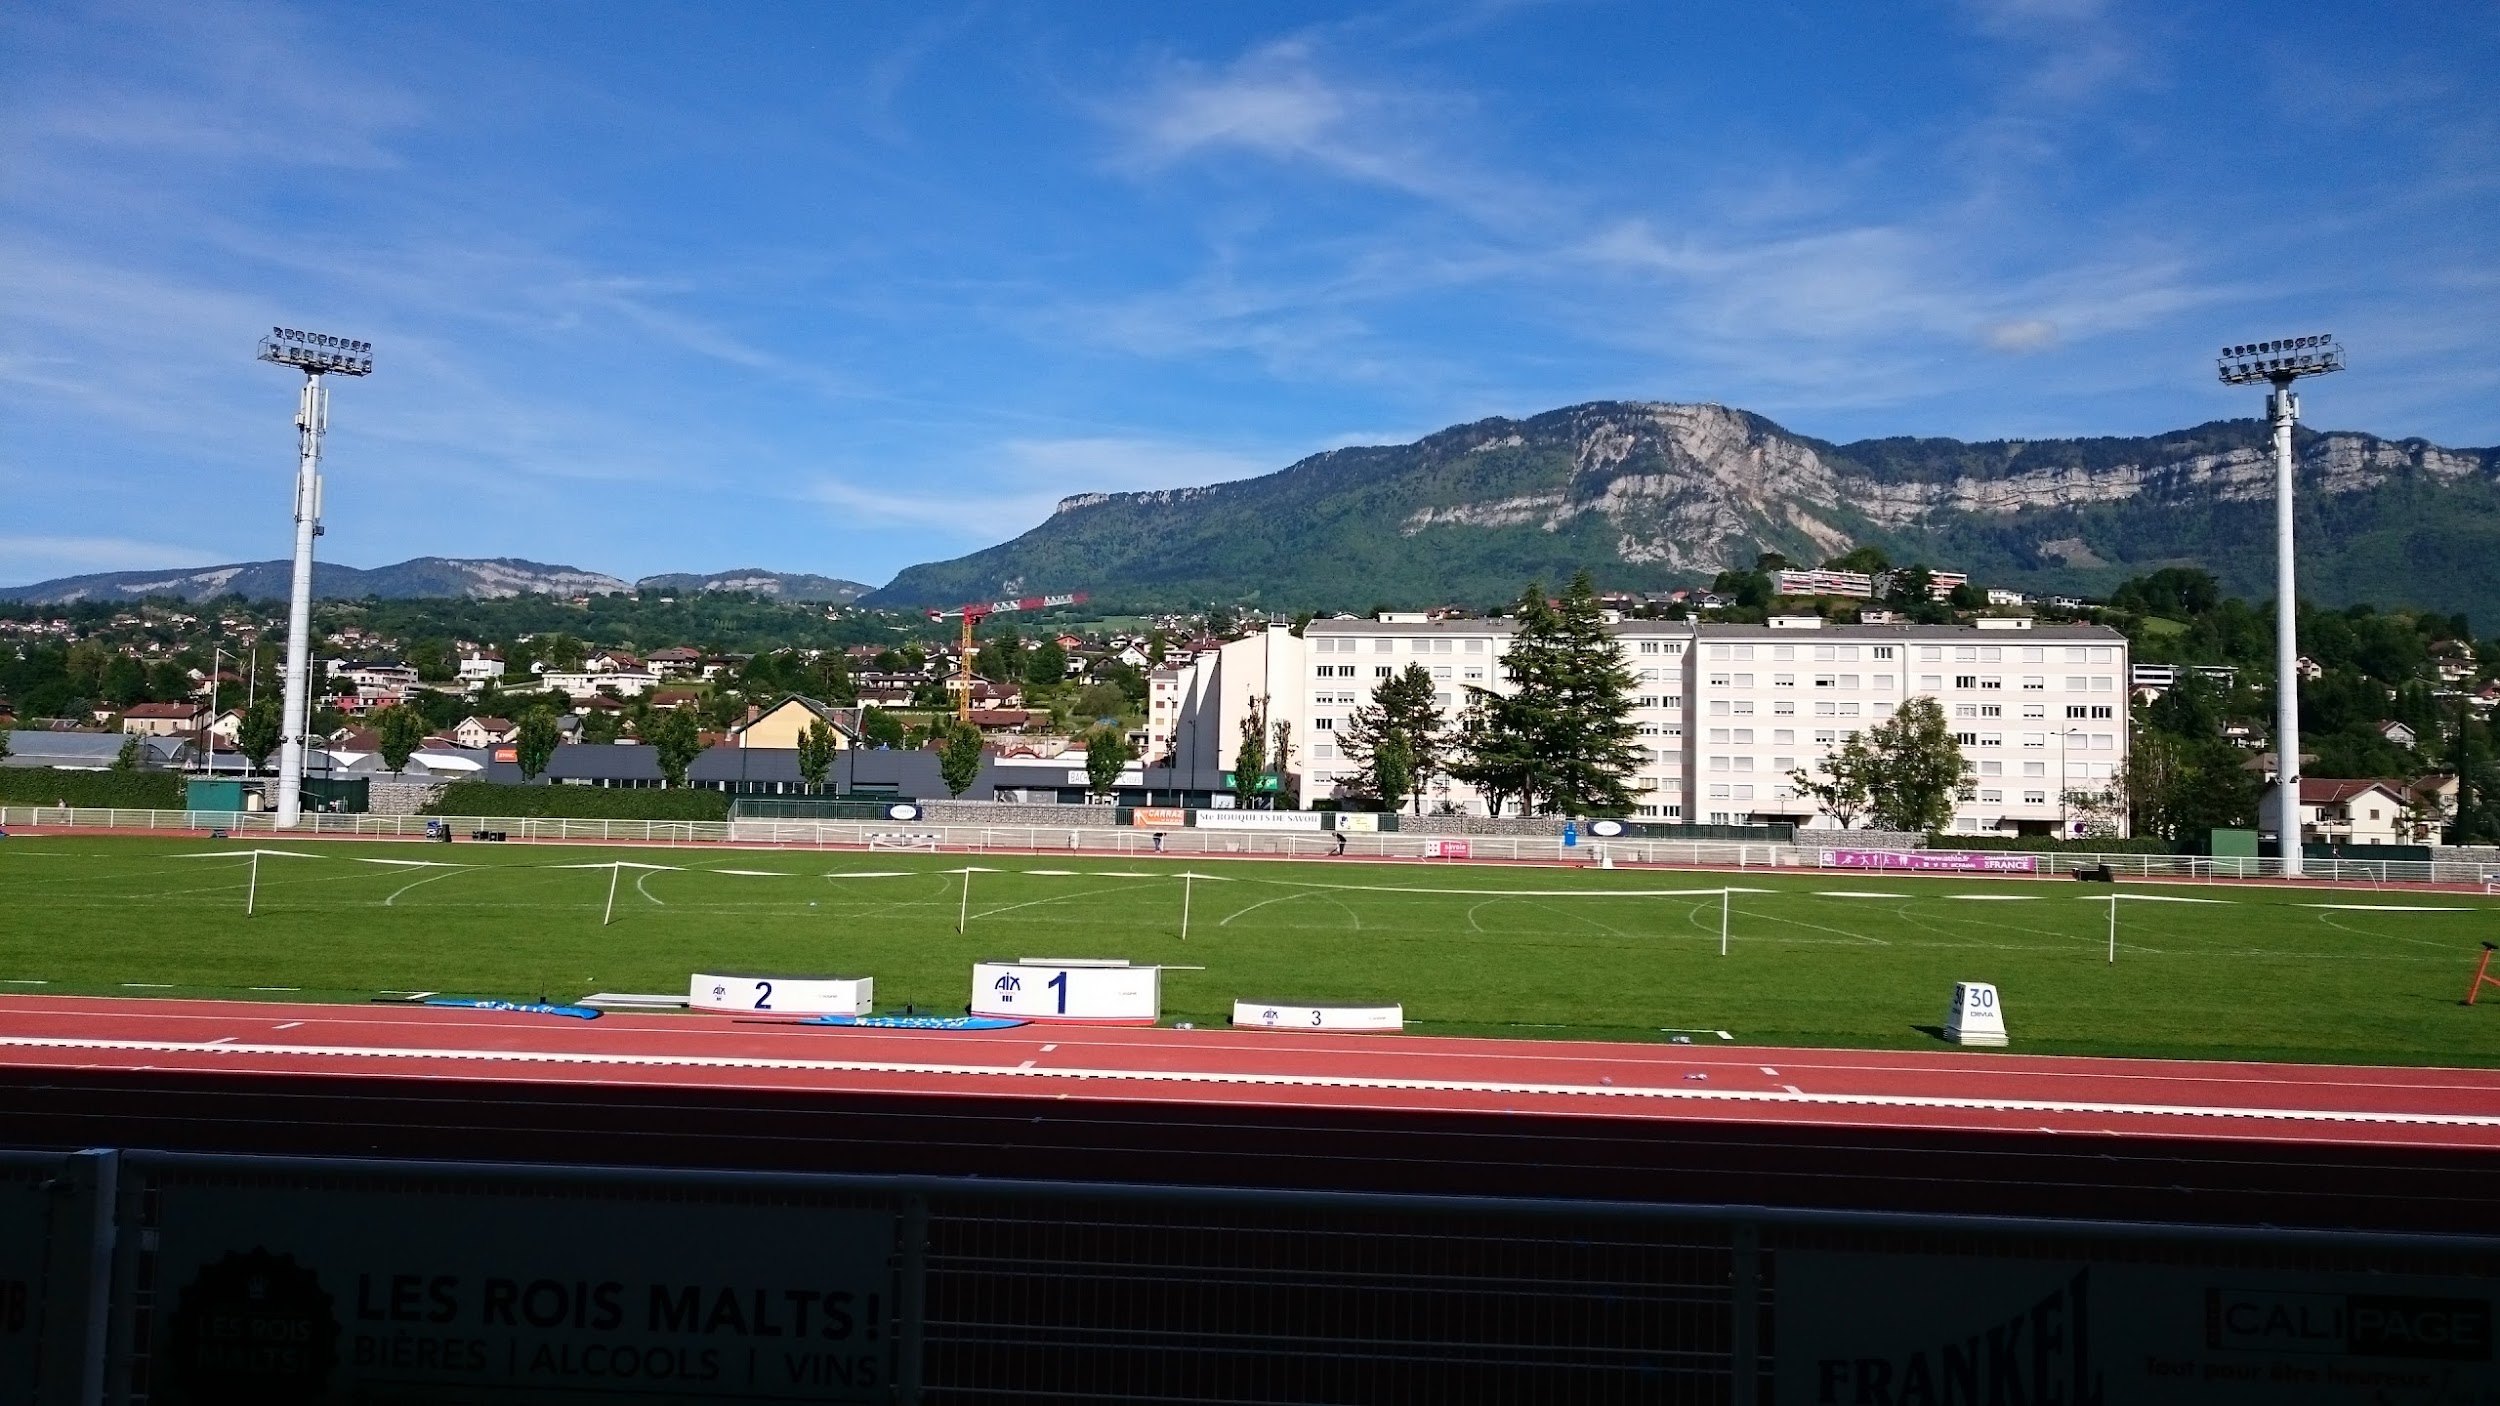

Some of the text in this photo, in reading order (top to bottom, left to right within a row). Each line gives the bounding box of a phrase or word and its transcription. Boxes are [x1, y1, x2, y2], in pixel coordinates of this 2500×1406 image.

[1990, 861, 2029, 870] FRANCE
[754, 981, 772, 1009] 2
[1048, 971, 1067, 1014] 1
[1970, 988, 1993, 1007] 30
[1311, 1010, 1322, 1026] 3
[358, 1273, 880, 1341] LES ROIS MALTS!
[1817, 1264, 2104, 1406] FRANKEL
[353, 1330, 878, 1388] BIÈRES ALCOOLS VINS
